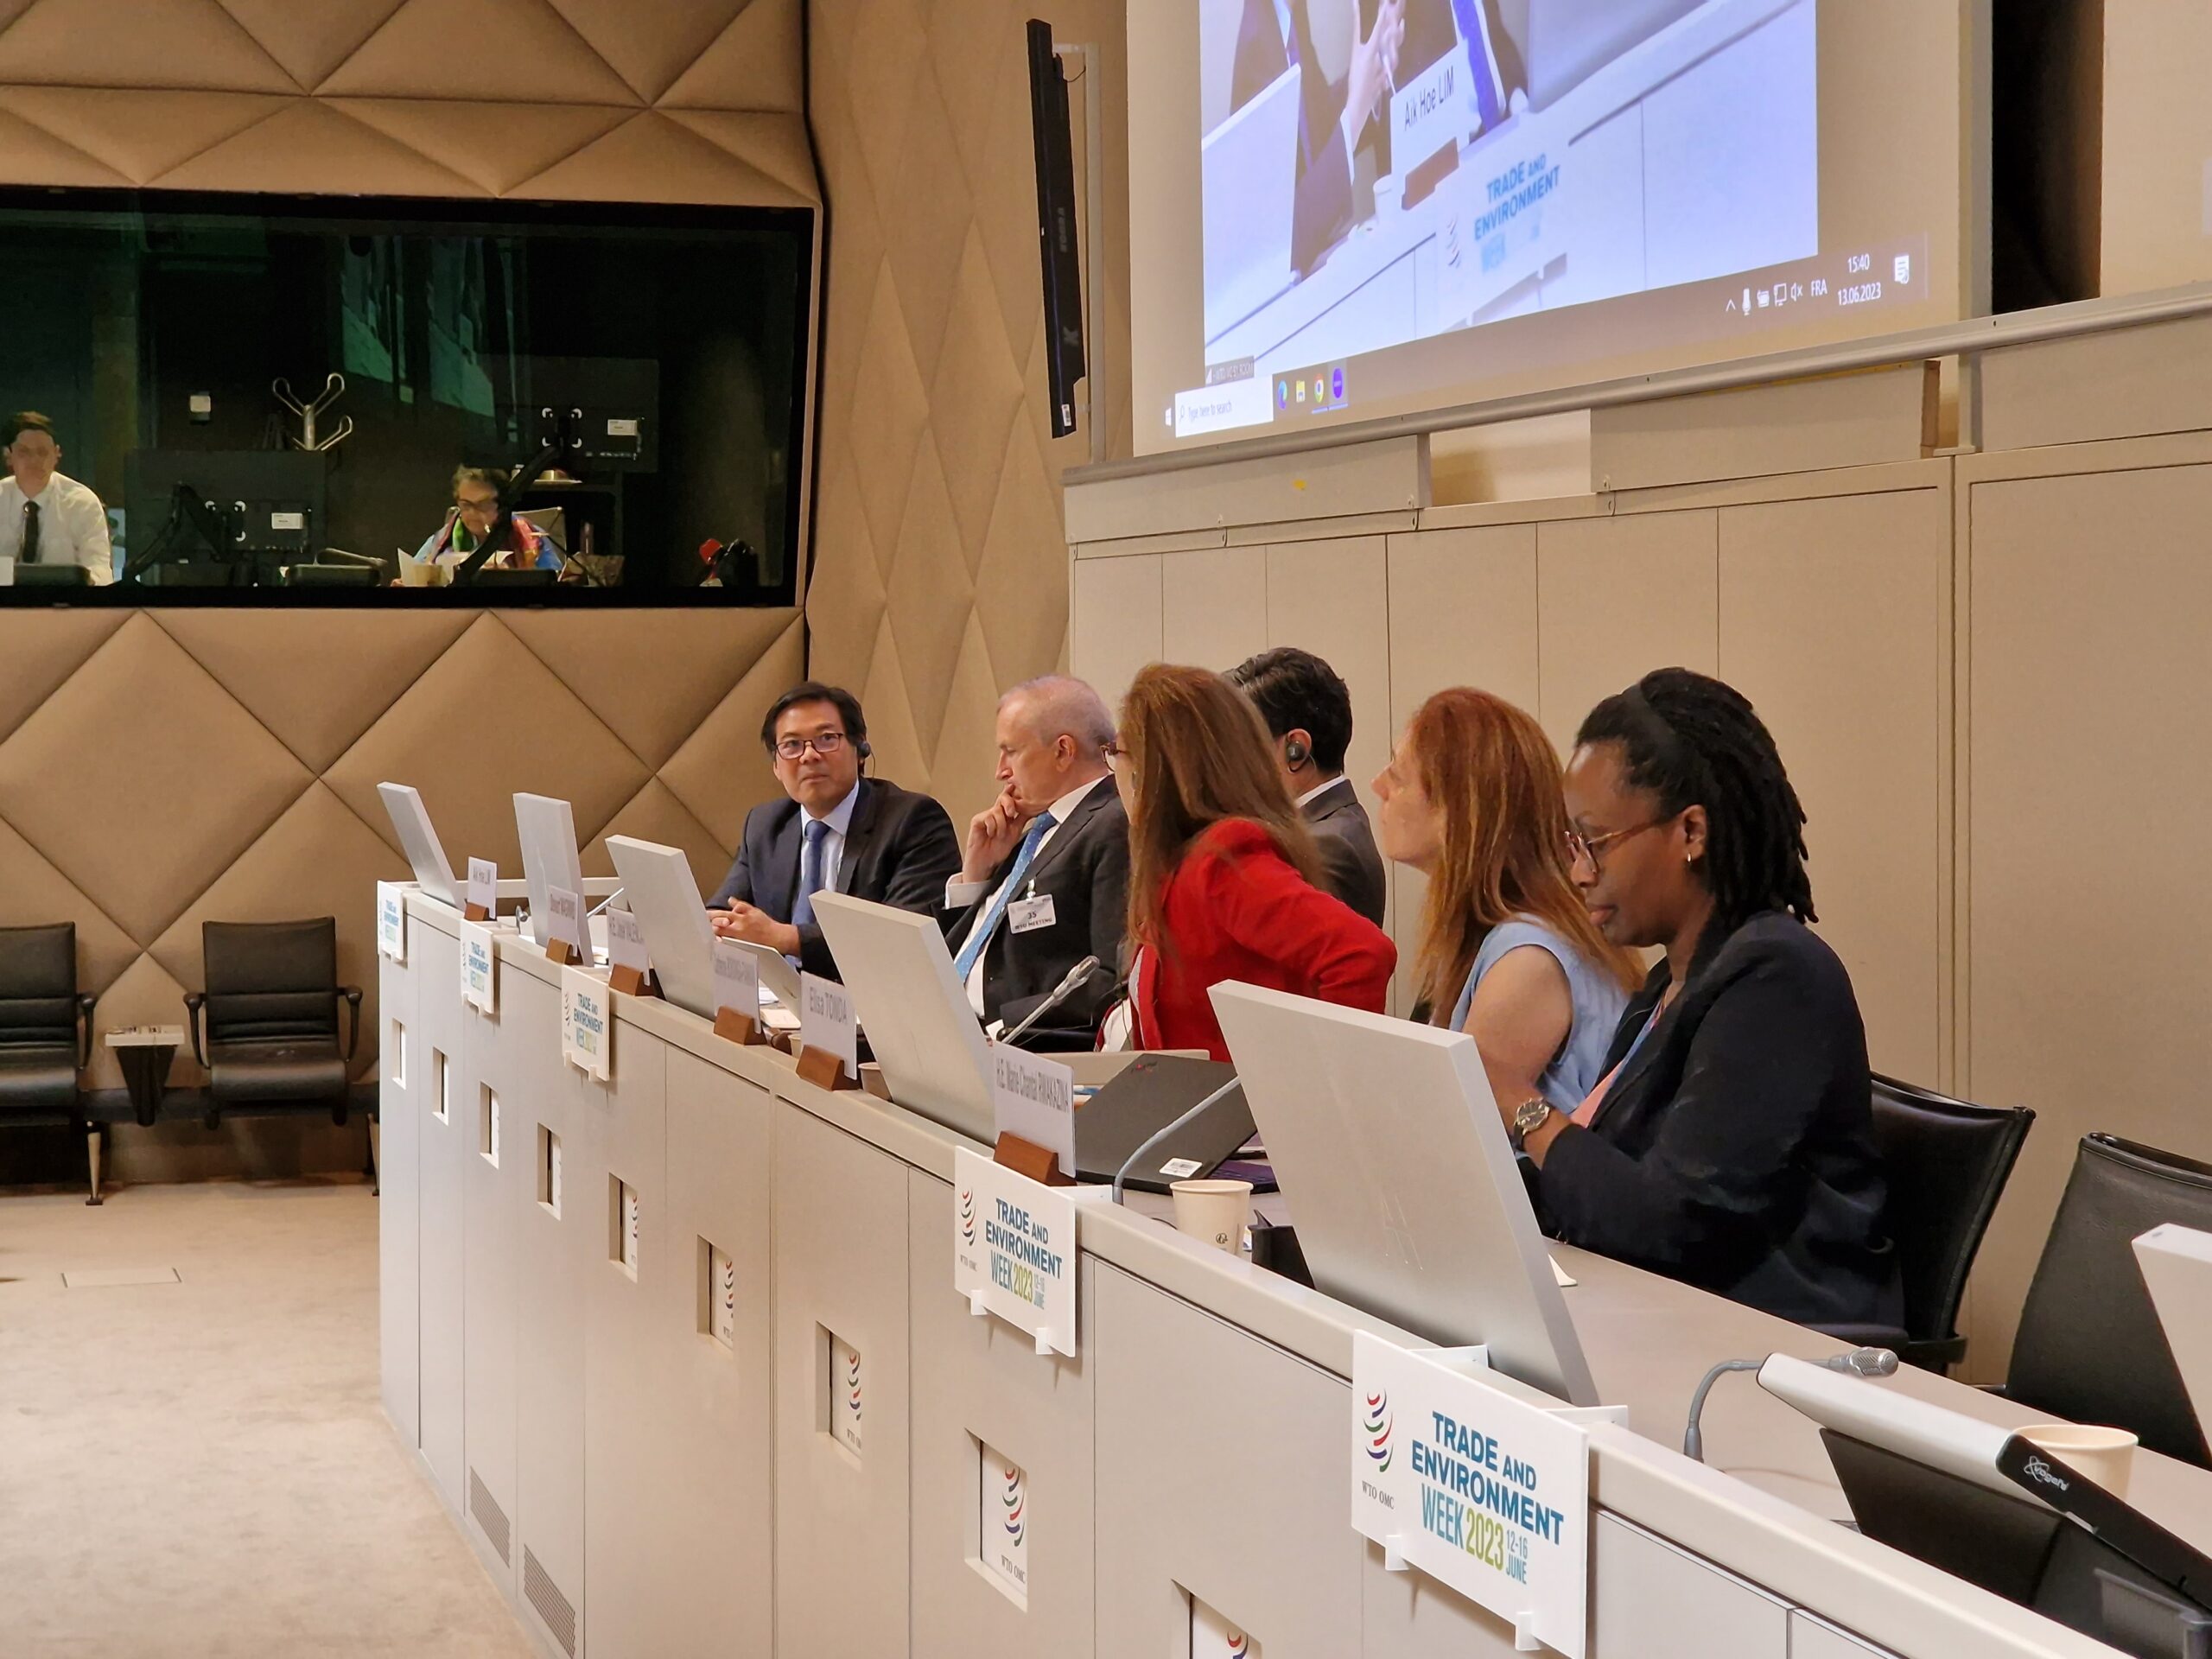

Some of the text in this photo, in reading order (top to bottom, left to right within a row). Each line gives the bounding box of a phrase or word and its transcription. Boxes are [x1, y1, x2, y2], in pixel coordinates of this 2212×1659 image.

[1420, 86, 1436, 118] Hoe
[1439, 66, 1454, 104] LIM
[1487, 153, 1546, 203] TRADE AND
[1474, 165, 1560, 241] ENVIRONMENT
[1847, 253, 1870, 273] 15:40
[1811, 278, 1827, 297] FRA
[1838, 282, 1881, 305] 13.06.2023
[996, 1198, 1049, 1244] TRADE AND
[986, 1219, 1062, 1279] ENVIRONMENT
[990, 1249, 1033, 1303] WEEK 2023
[1433, 1410, 1536, 1491] TRADE AND
[1362, 1480, 1395, 1510] WTO OMC
[1412, 1440, 1564, 1545] ENVIRONMENT
[1421, 1483, 1503, 1571] WEEK 2023
[1506, 1529, 1528, 1560] 12-16
[1001, 1554, 1013, 1574] WTO
[1506, 1554, 1527, 1585] JUNE
